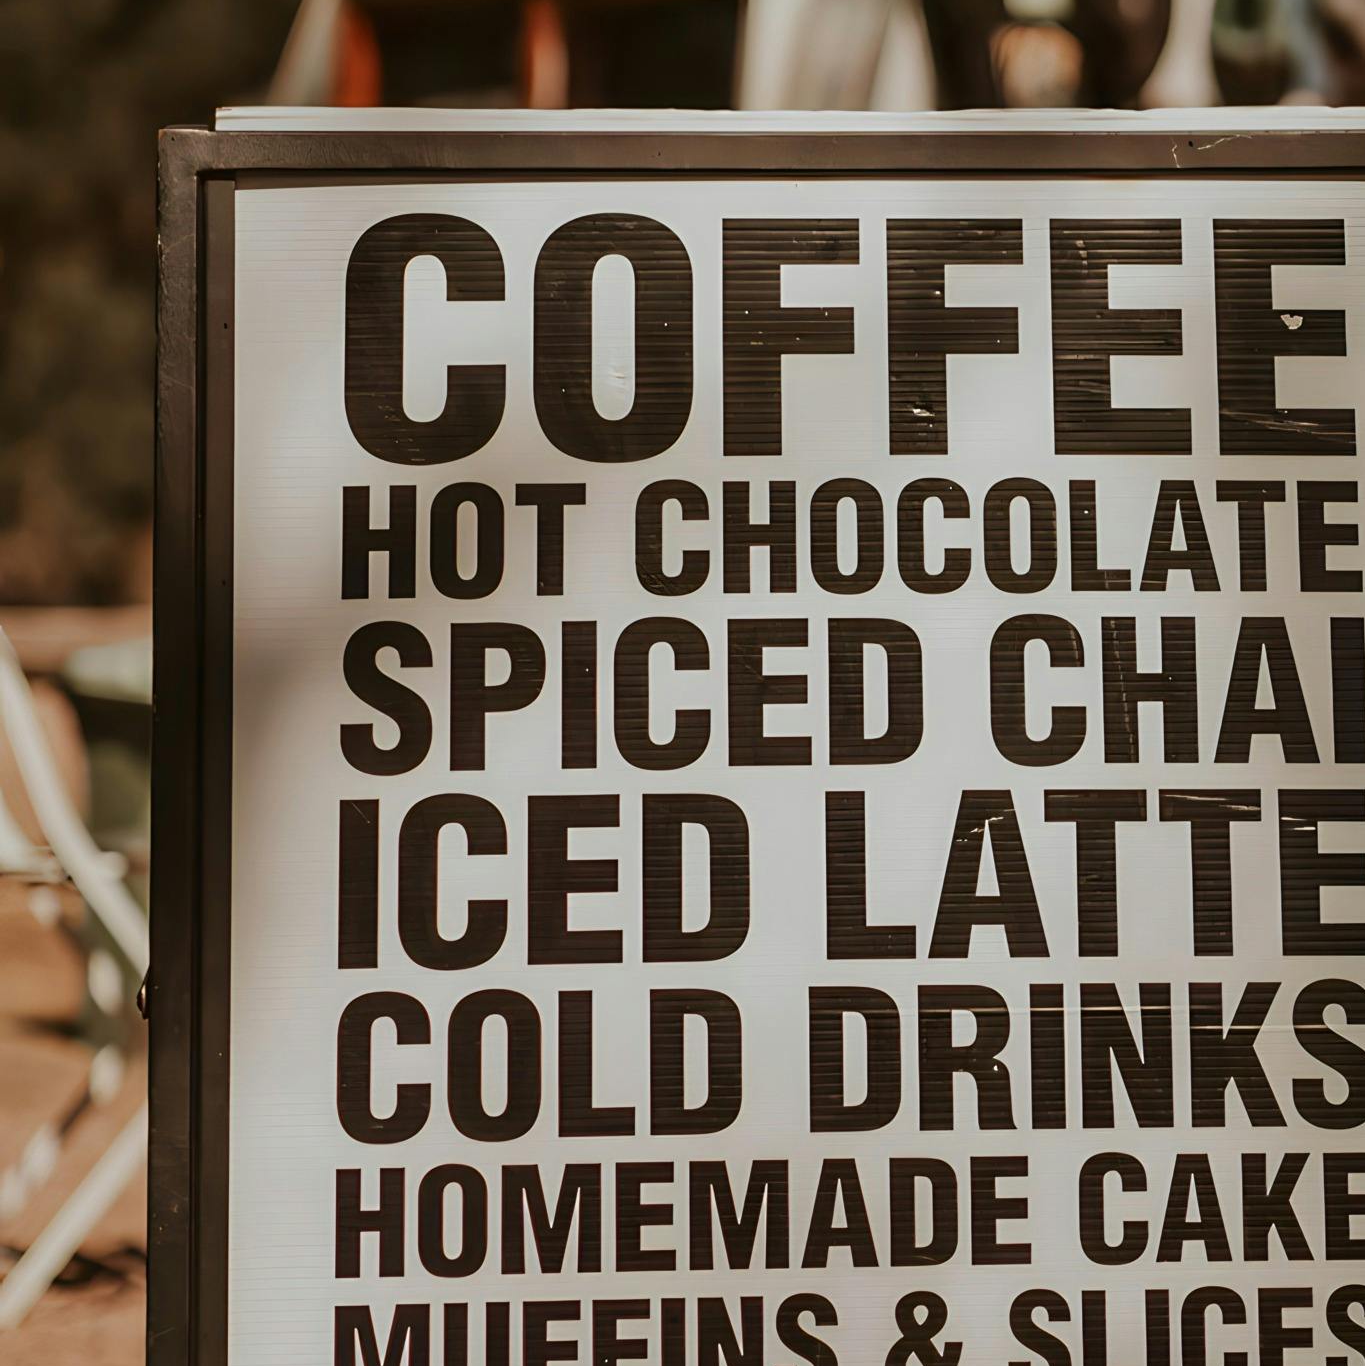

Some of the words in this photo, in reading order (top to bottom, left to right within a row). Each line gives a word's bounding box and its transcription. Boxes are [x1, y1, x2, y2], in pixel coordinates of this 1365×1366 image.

[345, 213, 1356, 465] COFFEE
[341, 482, 586, 600] HOT
[635, 478, 1363, 596] CHOCOLATE
[340, 617, 923, 776] SPICED
[338, 793, 750, 970] ICED
[337, 989, 742, 1144] COLD
[335, 1156, 1031, 1278] HOMEMADE
